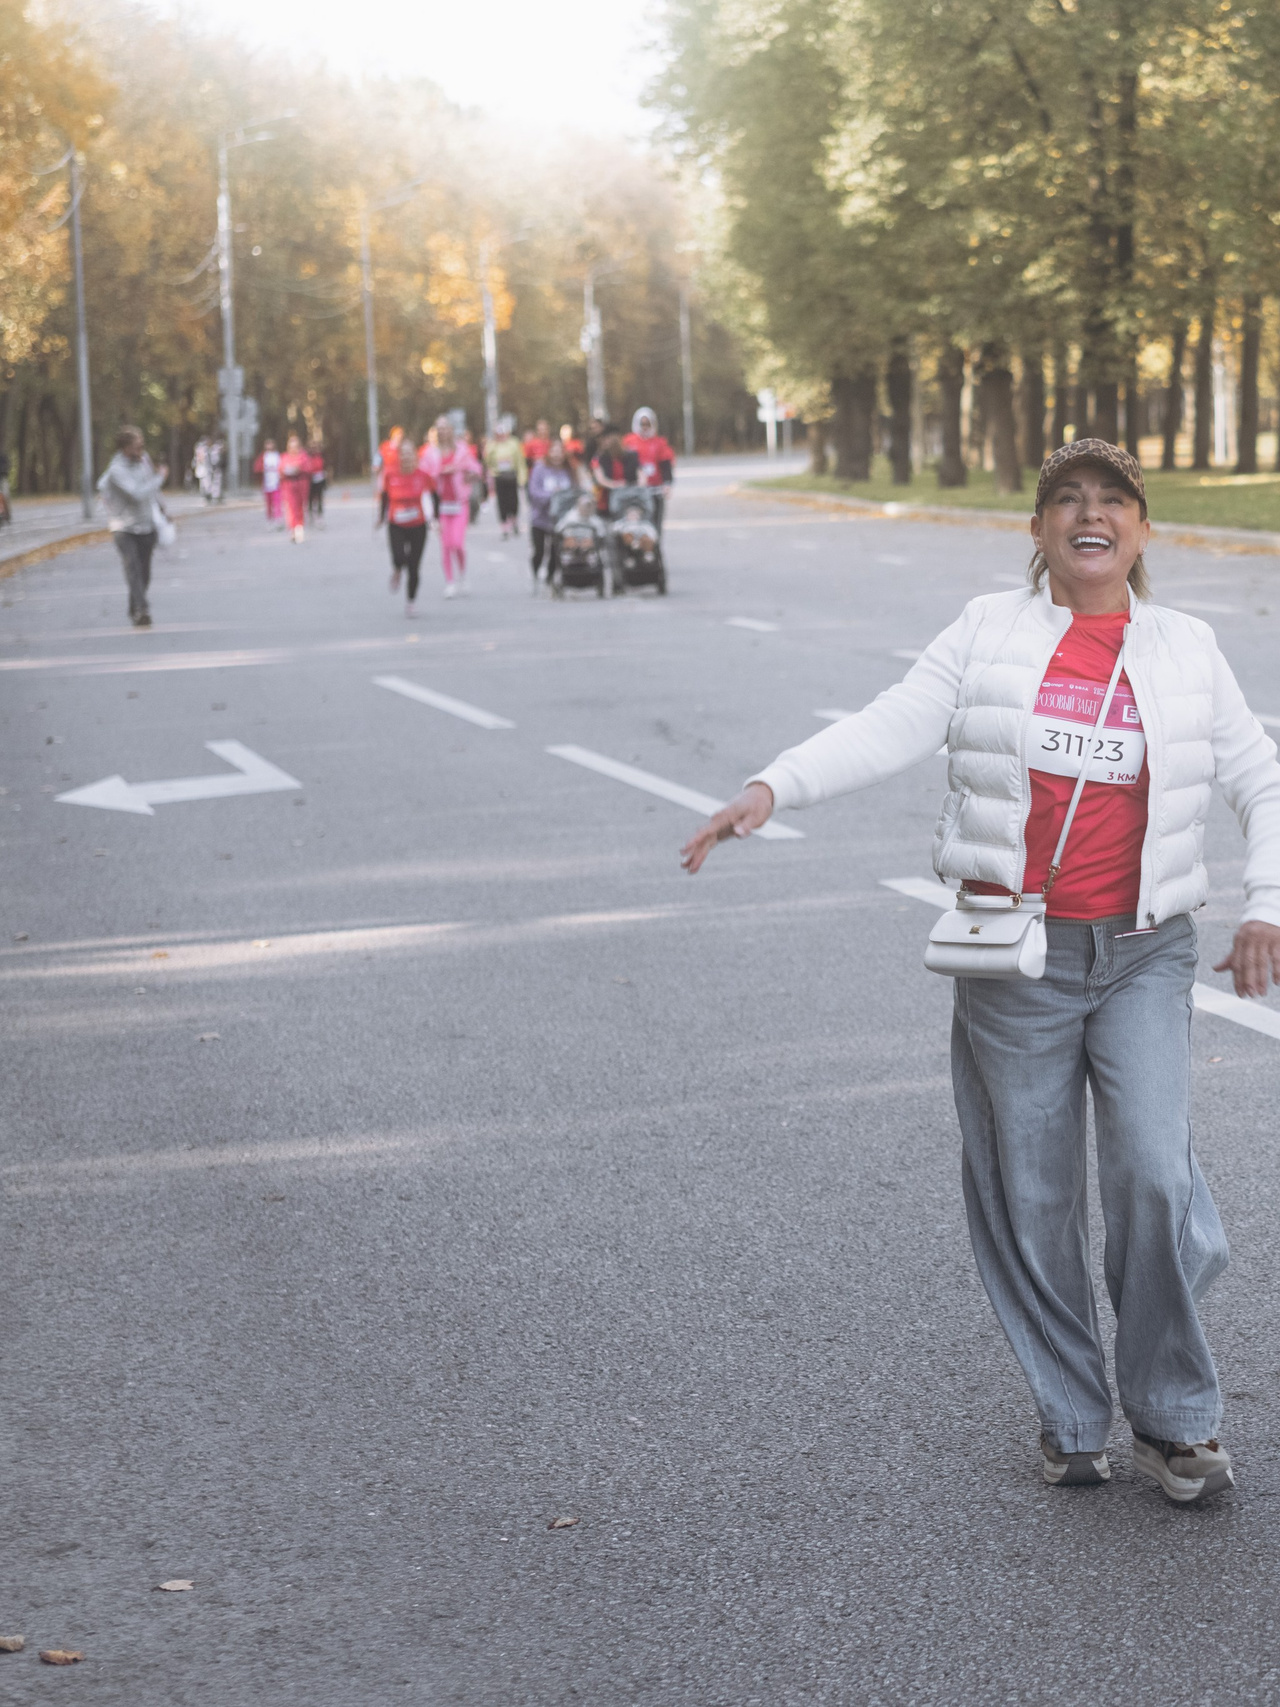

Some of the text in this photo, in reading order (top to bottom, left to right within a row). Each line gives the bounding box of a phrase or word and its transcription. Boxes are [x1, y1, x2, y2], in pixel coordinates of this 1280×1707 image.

[1036, 692, 1099, 717] РОЗОВЫЙ ЗАБЕГ
[1041, 729, 1124, 762] 31123
[1107, 772, 1114, 781] 3
